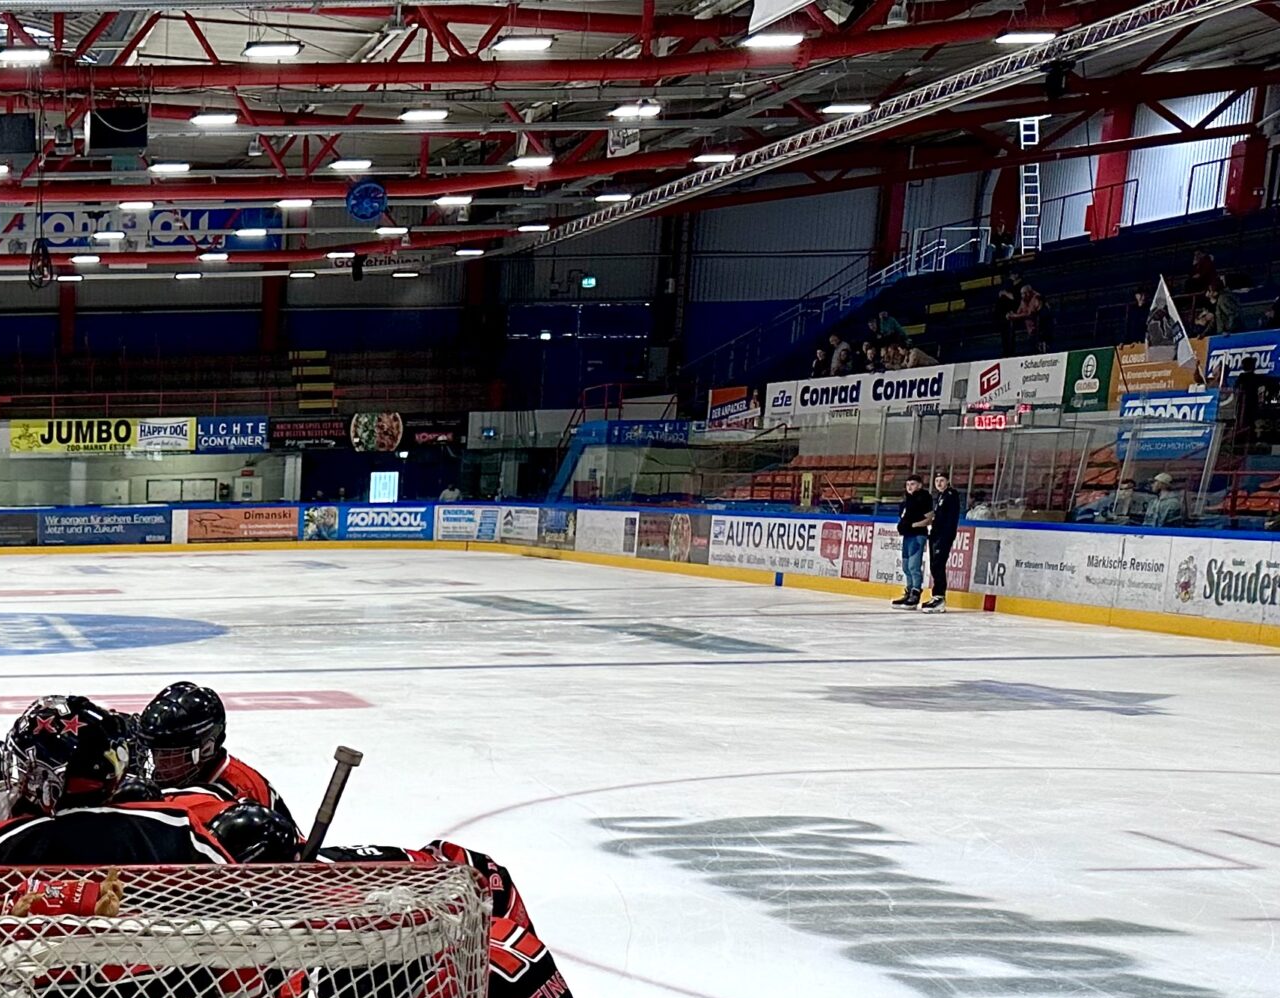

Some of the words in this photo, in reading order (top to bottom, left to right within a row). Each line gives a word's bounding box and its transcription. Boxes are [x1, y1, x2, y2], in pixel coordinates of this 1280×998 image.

[872, 372, 944, 401] Conrad
[980, 367, 1000, 390] TB
[800, 380, 862, 407] Conrad
[40, 419, 132, 444] JUMBO
[140, 423, 169, 437] HAPPY
[170, 423, 188, 437] DOG
[198, 422, 267, 435] LICHTE
[201, 435, 263, 447] CONTAINER
[243, 509, 292, 520] Dimanski
[725, 520, 763, 548] AUTO
[766, 521, 817, 552] KRUSE
[846, 524, 873, 544] REWE
[1014, 558, 1024, 568] Wir
[1086, 554, 1125, 570] Märkische
[1129, 556, 1165, 574] Revision
[986, 561, 1006, 587] MR
[1202, 557, 1280, 606] Stauder
